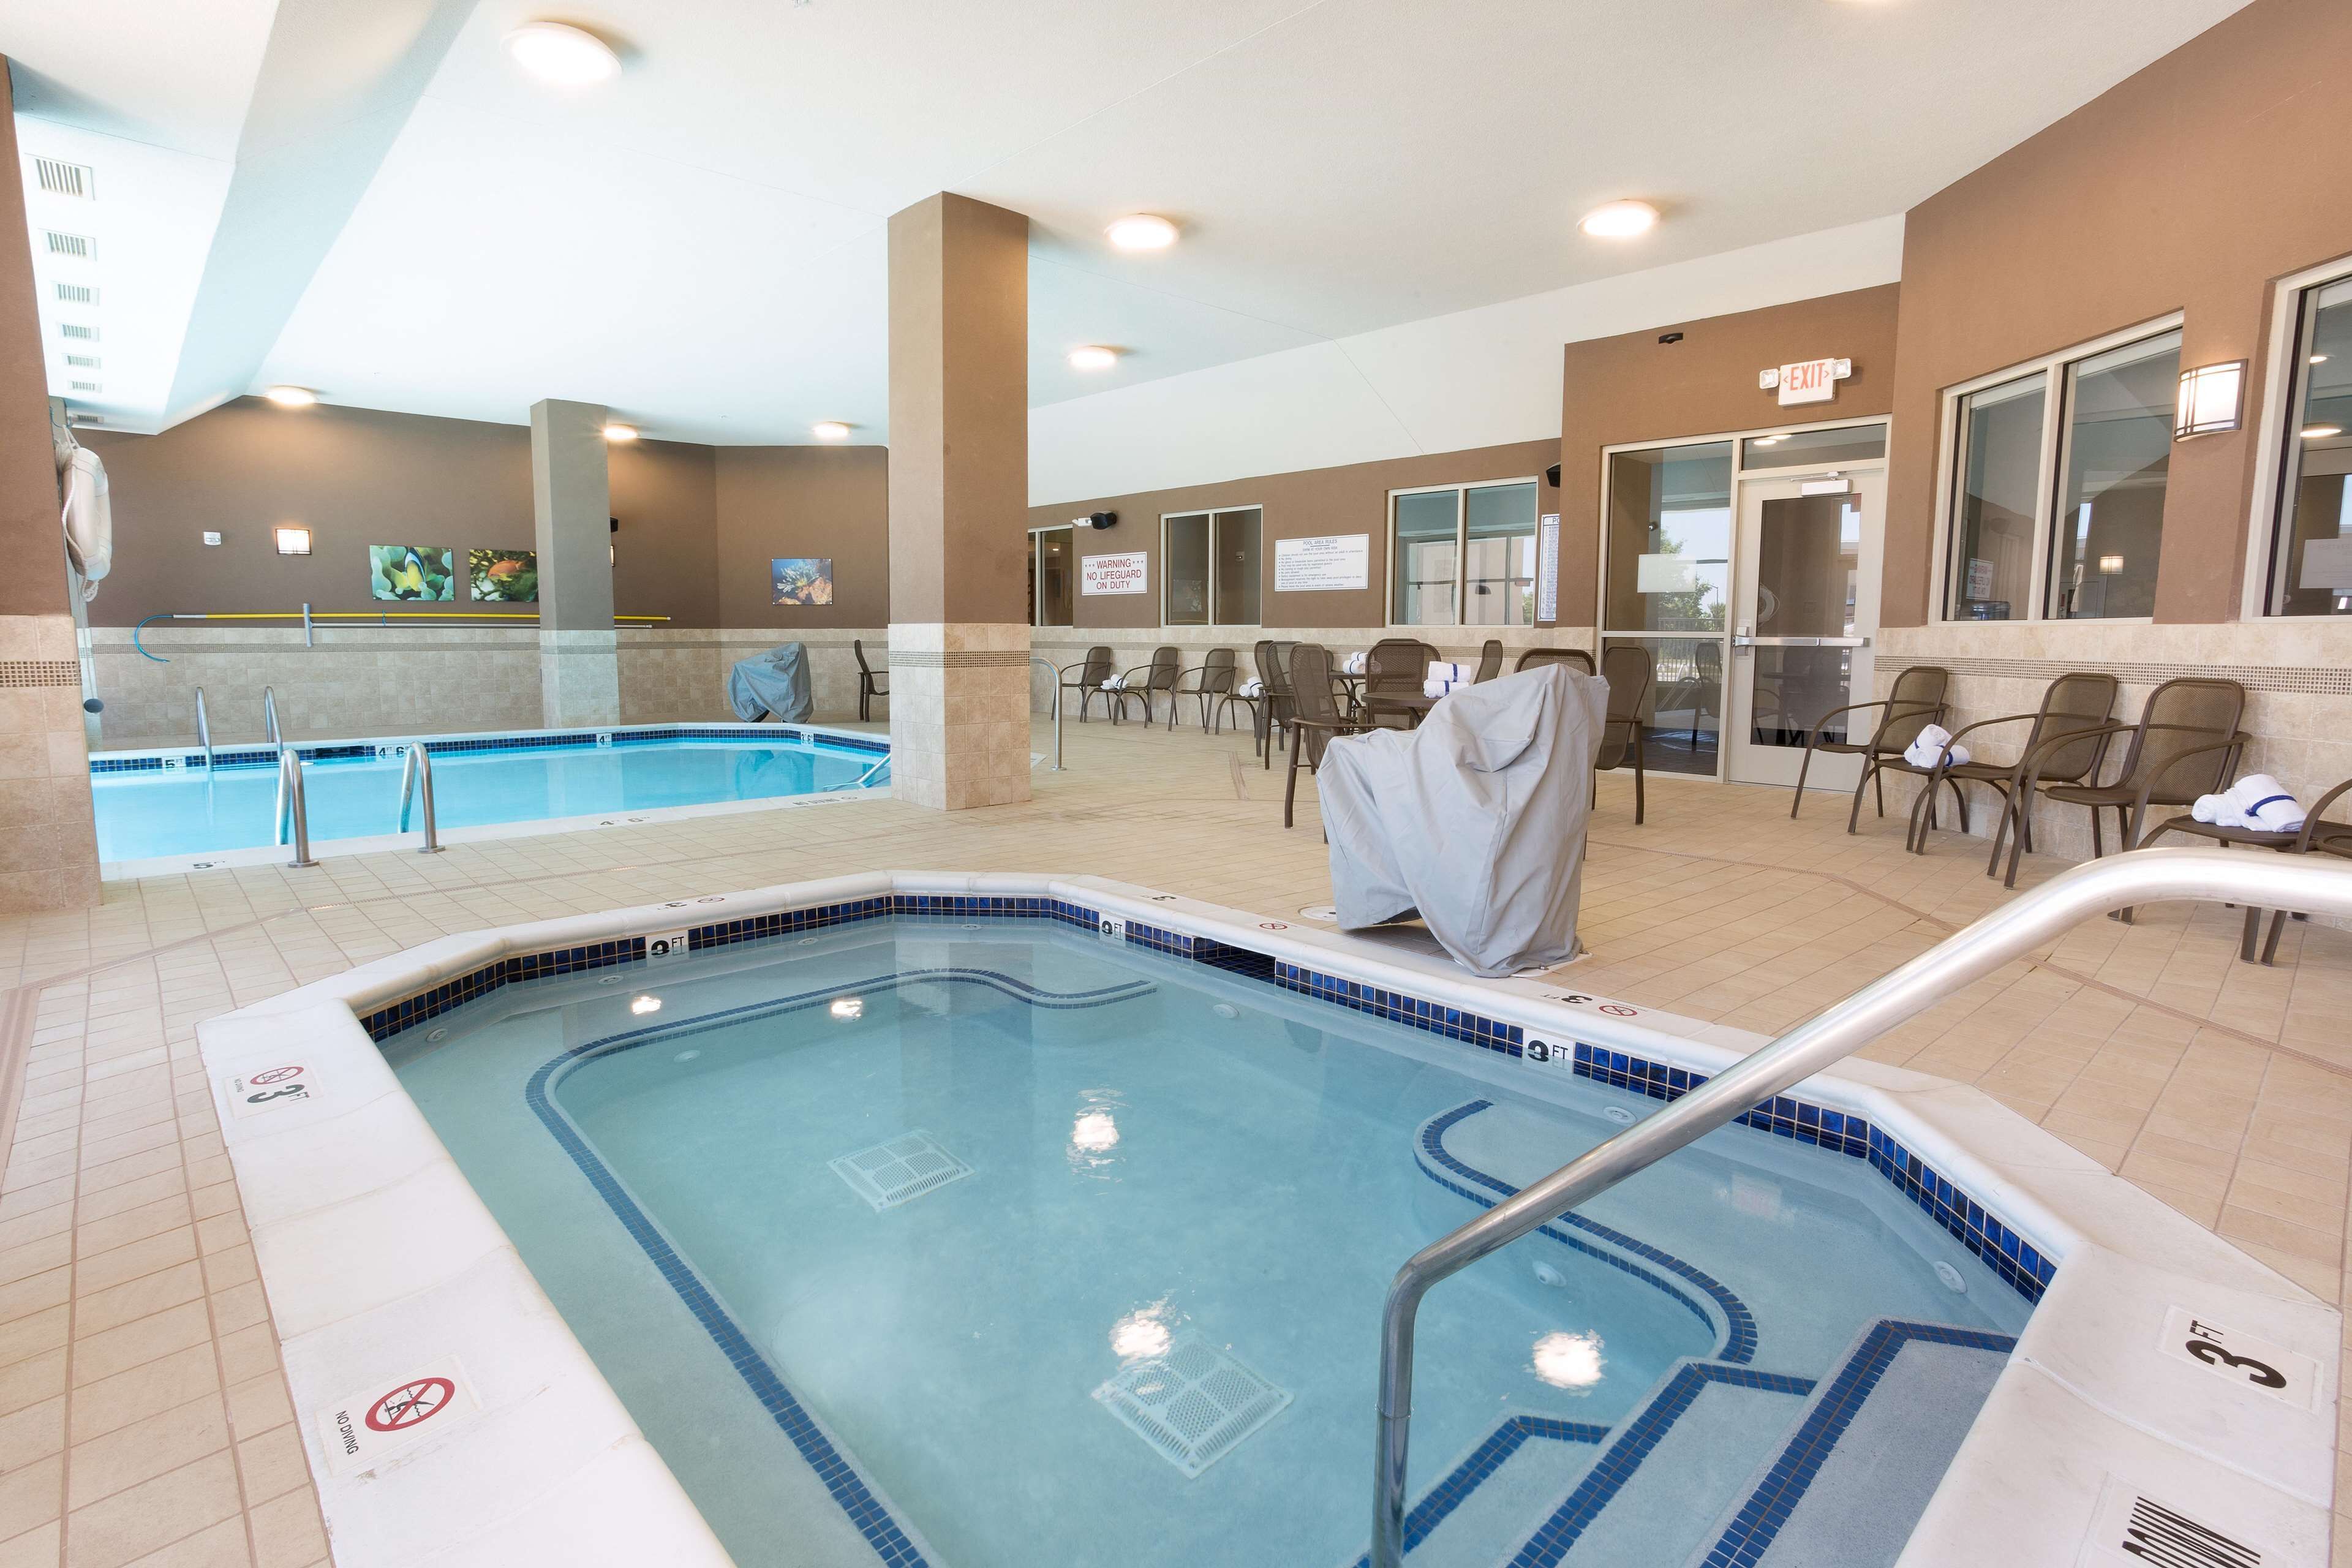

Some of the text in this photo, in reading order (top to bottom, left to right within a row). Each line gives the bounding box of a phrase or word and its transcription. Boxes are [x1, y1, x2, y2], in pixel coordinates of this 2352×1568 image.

[1790, 363, 1825, 391] EXIT
[1097, 559, 1131, 569] WARNING
[1087, 569, 1142, 581] NO LIFEGUARD
[379, 747, 386, 756] 4
[165, 759, 175, 768] 5
[1114, 922, 1123, 933] FT
[672, 936, 684, 948] FT
[1561, 995, 1593, 1004] 3
[1552, 1044, 1569, 1060] FT
[247, 1084, 310, 1103] 3 FT
[2185, 1319, 2286, 1389] 3 FT
[335, 1410, 359, 1455] NO DIVING
